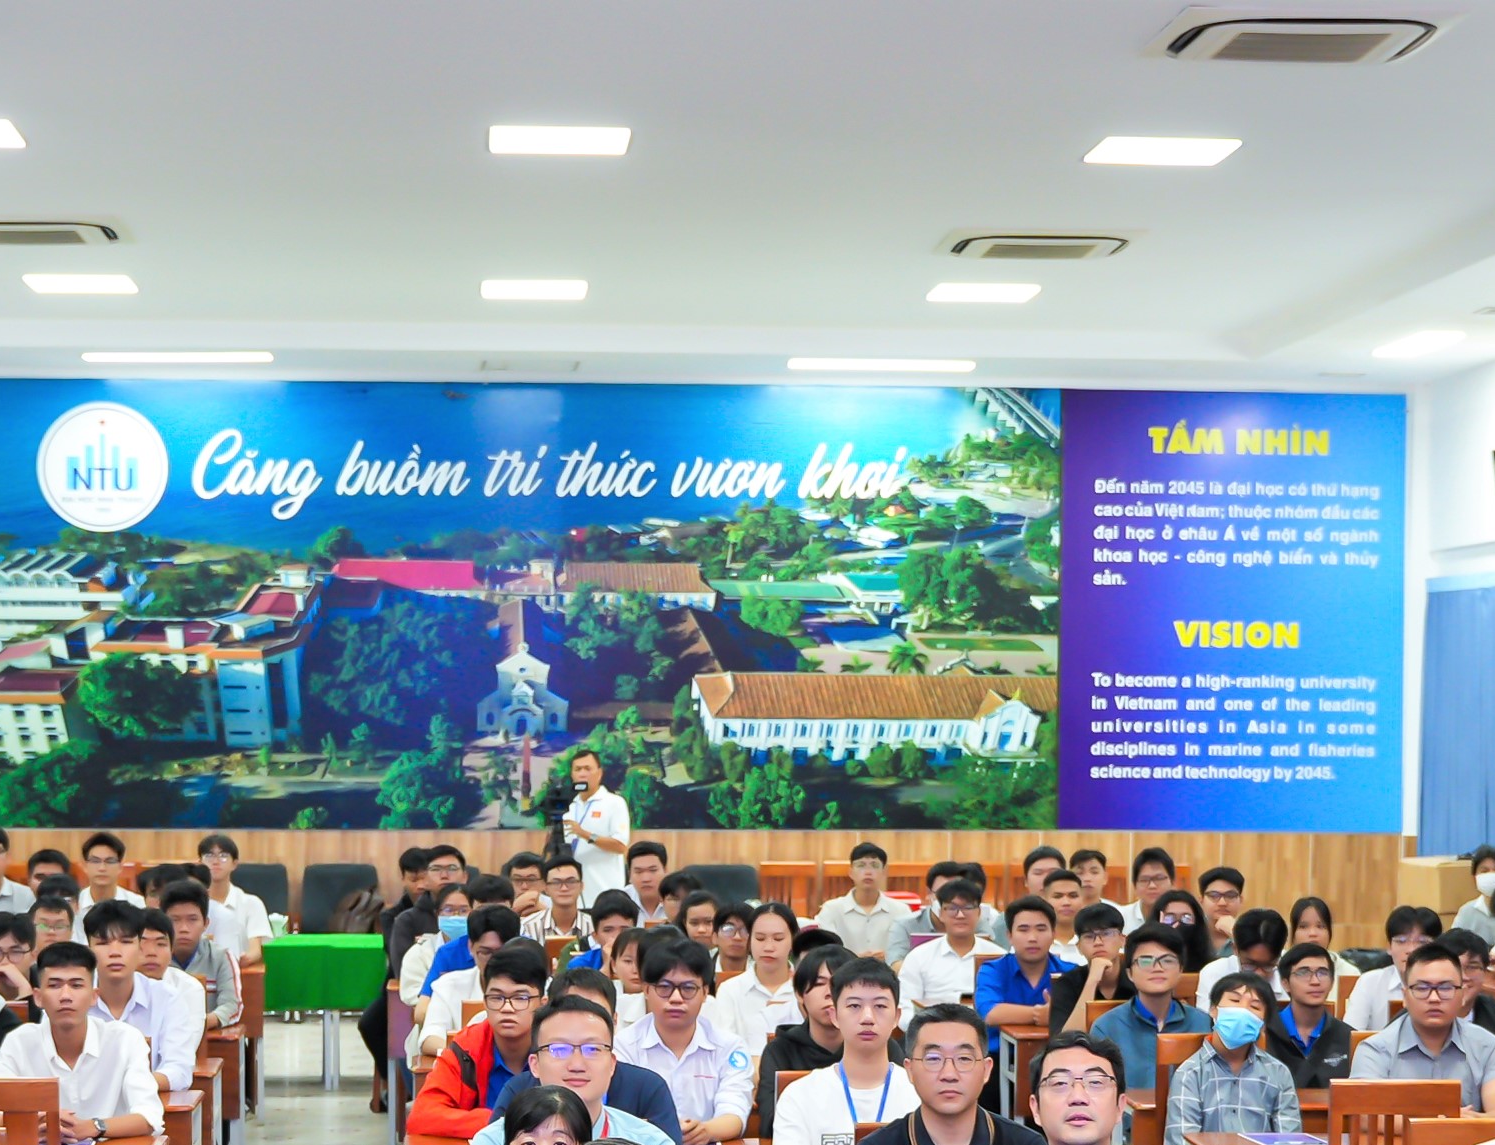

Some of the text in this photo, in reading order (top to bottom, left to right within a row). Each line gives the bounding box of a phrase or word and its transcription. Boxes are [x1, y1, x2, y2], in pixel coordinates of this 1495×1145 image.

[1148, 420, 1330, 456] TẦM NHÌN
[72, 467, 135, 492] NTU
[192, 428, 322, 520] Căng
[336, 441, 470, 496] buồm
[484, 445, 547, 497] tri
[556, 442, 656, 497] thức
[1094, 477, 1126, 493] Đến
[1130, 480, 1164, 494] năm
[1168, 480, 1204, 495] 2045
[1209, 481, 1223, 495] là
[1227, 481, 1251, 497] đại
[1255, 482, 1284, 497] học
[1340, 483, 1380, 500] hạng
[1093, 504, 1123, 516] cao
[1154, 502, 1184, 519] Việt
[1228, 504, 1272, 520] thuộc
[1350, 506, 1379, 520] các
[1093, 524, 1119, 542] đại
[1125, 525, 1155, 542] học
[1266, 527, 1297, 543] một
[1329, 529, 1379, 545] ngành
[1093, 547, 1132, 562] khoa
[1138, 548, 1167, 565] học
[1186, 549, 1227, 567] công
[1232, 550, 1273, 567] nghệ
[1278, 547, 1313, 564] biển
[1319, 551, 1338, 565] và
[1092, 569, 1126, 585] sản.
[1174, 620, 1300, 649] VISION
[1090, 672, 1376, 692] To become a high-ranking university
[1091, 695, 1377, 714] in Vietnam and one of the leading
[1091, 717, 1376, 734] universities in Asia in some
[1090, 740, 1375, 758] disciplines in marine and fisheries
[1090, 763, 1151, 778] science
[1152, 764, 1183, 778] and
[1184, 765, 1271, 782] technology
[1273, 765, 1293, 782] by
